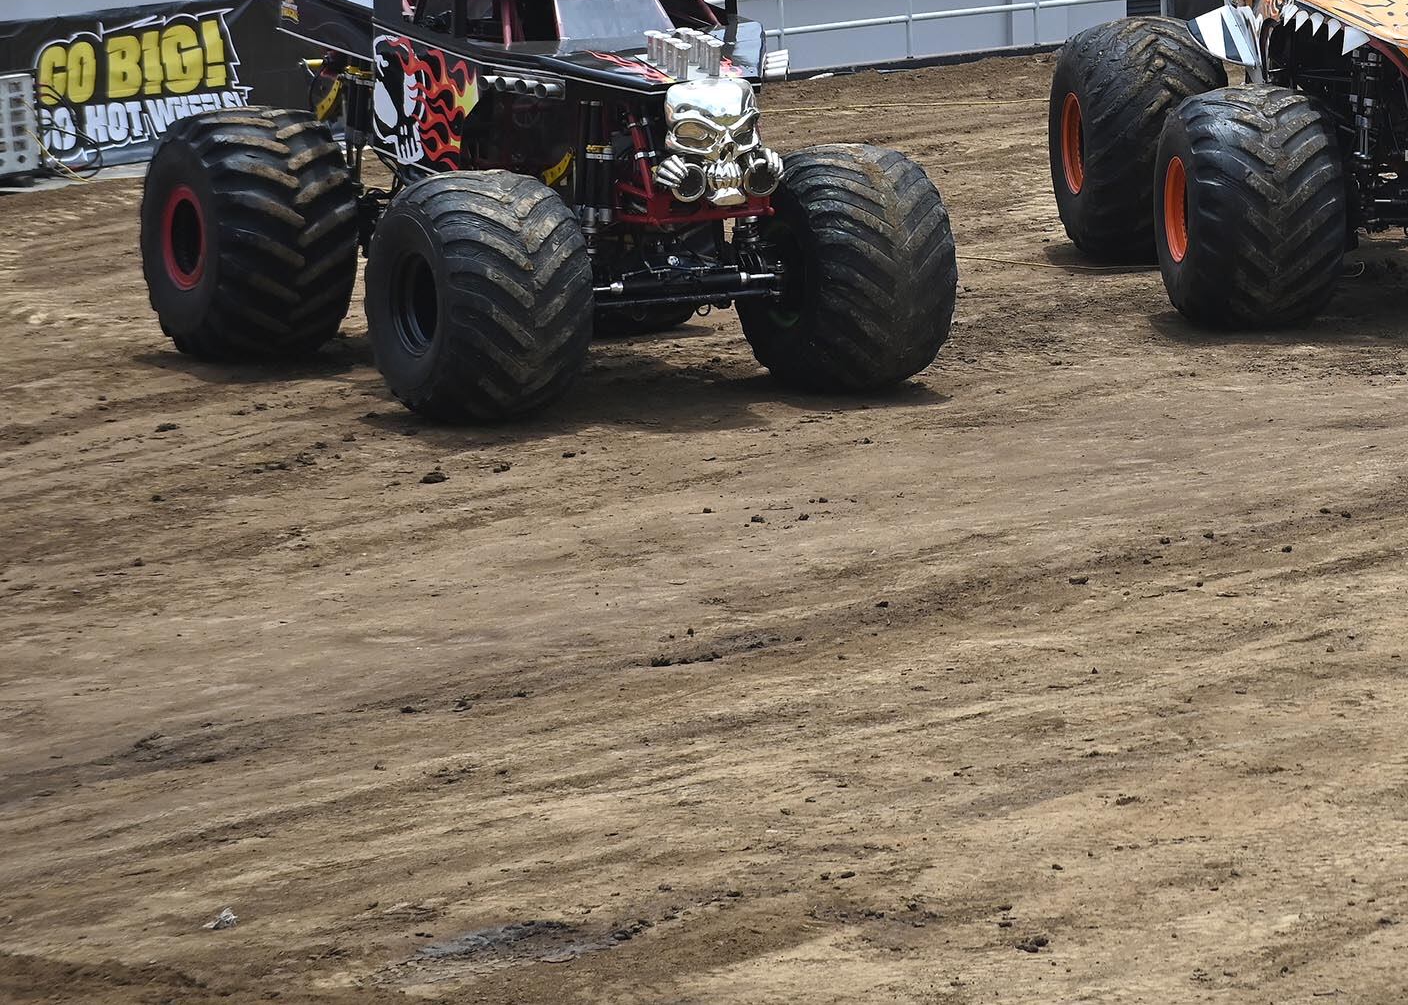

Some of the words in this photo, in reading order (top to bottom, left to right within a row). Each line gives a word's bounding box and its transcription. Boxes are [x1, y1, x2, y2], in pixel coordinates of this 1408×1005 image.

[39, 41, 96, 105] GO
[106, 19, 227, 99] BIG!
[85, 100, 143, 143] HOT
